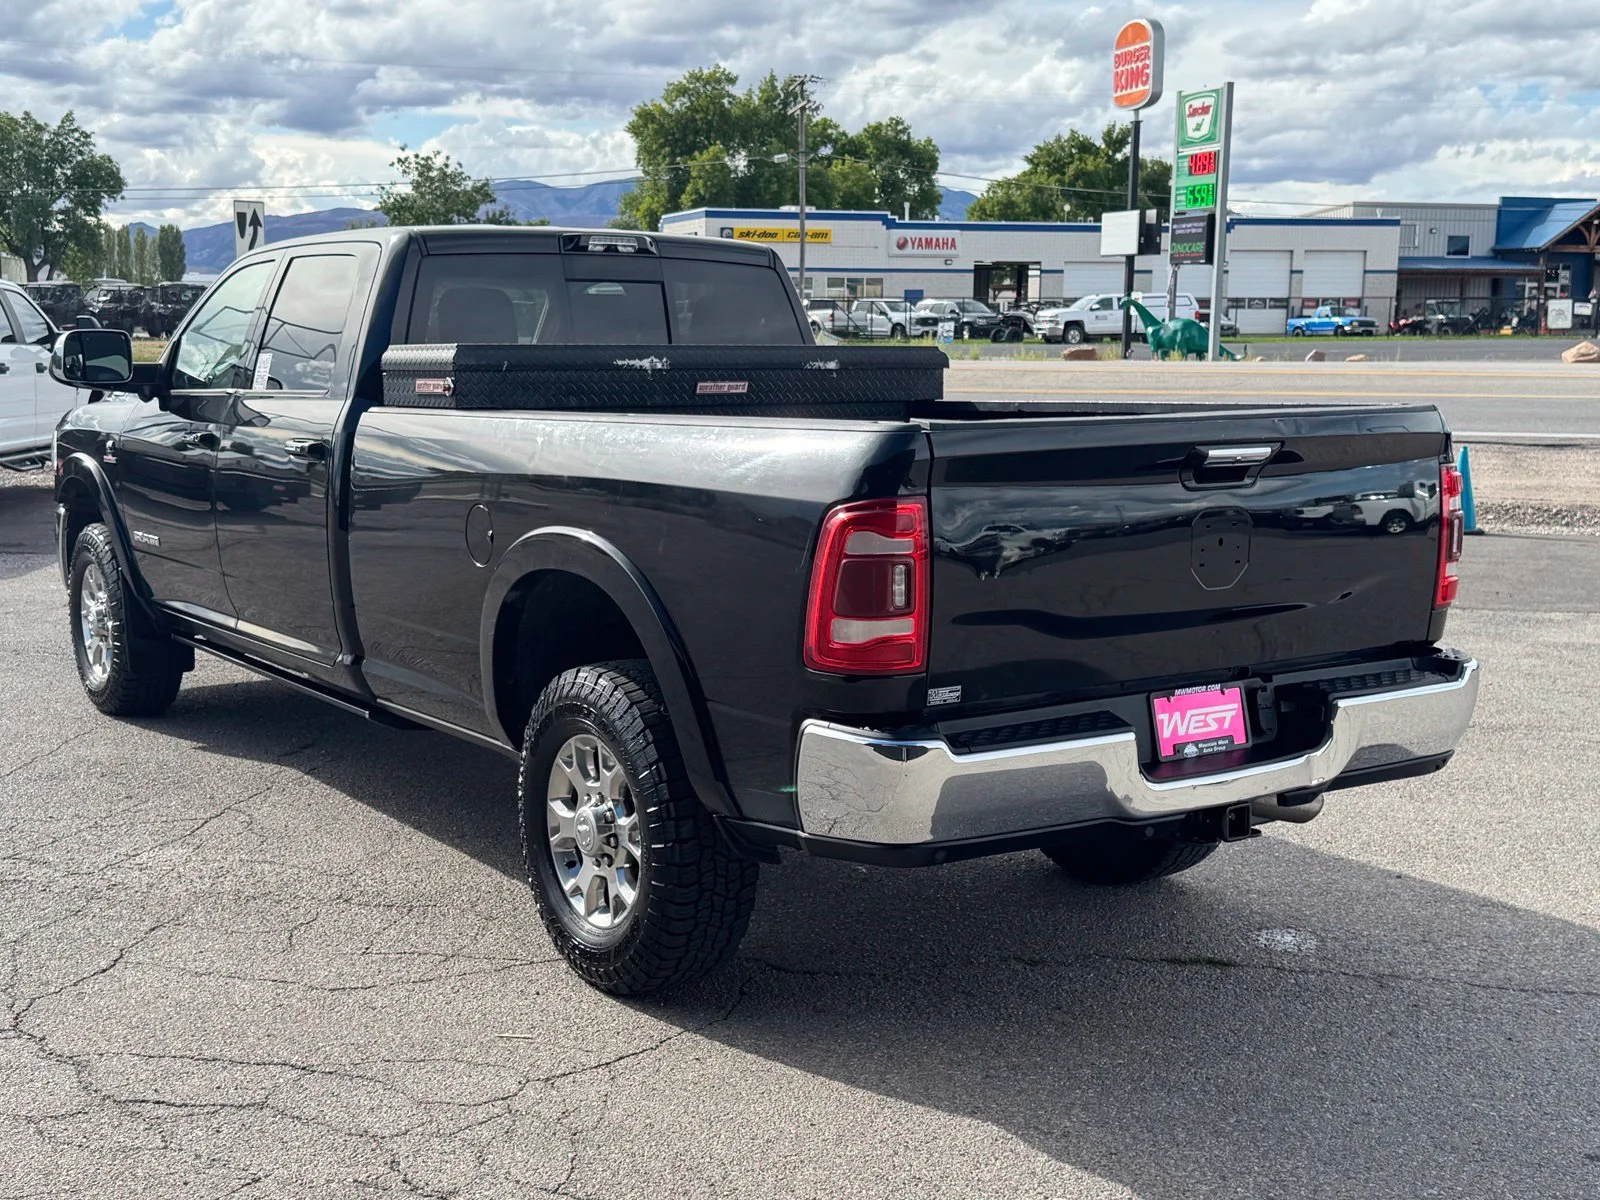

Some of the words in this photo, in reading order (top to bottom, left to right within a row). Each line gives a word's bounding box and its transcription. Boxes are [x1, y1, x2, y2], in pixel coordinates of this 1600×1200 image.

[1114, 45, 1150, 69] BURGER
[1114, 63, 1150, 93] KING
[738, 228, 778, 239] ski-doo
[787, 231, 829, 239] ca-am
[910, 237, 957, 250] YAMAHA
[727, 383, 746, 391] guard
[1174, 684, 1221, 696] MWMOTOR.COM
[1158, 704, 1238, 738] WEST
